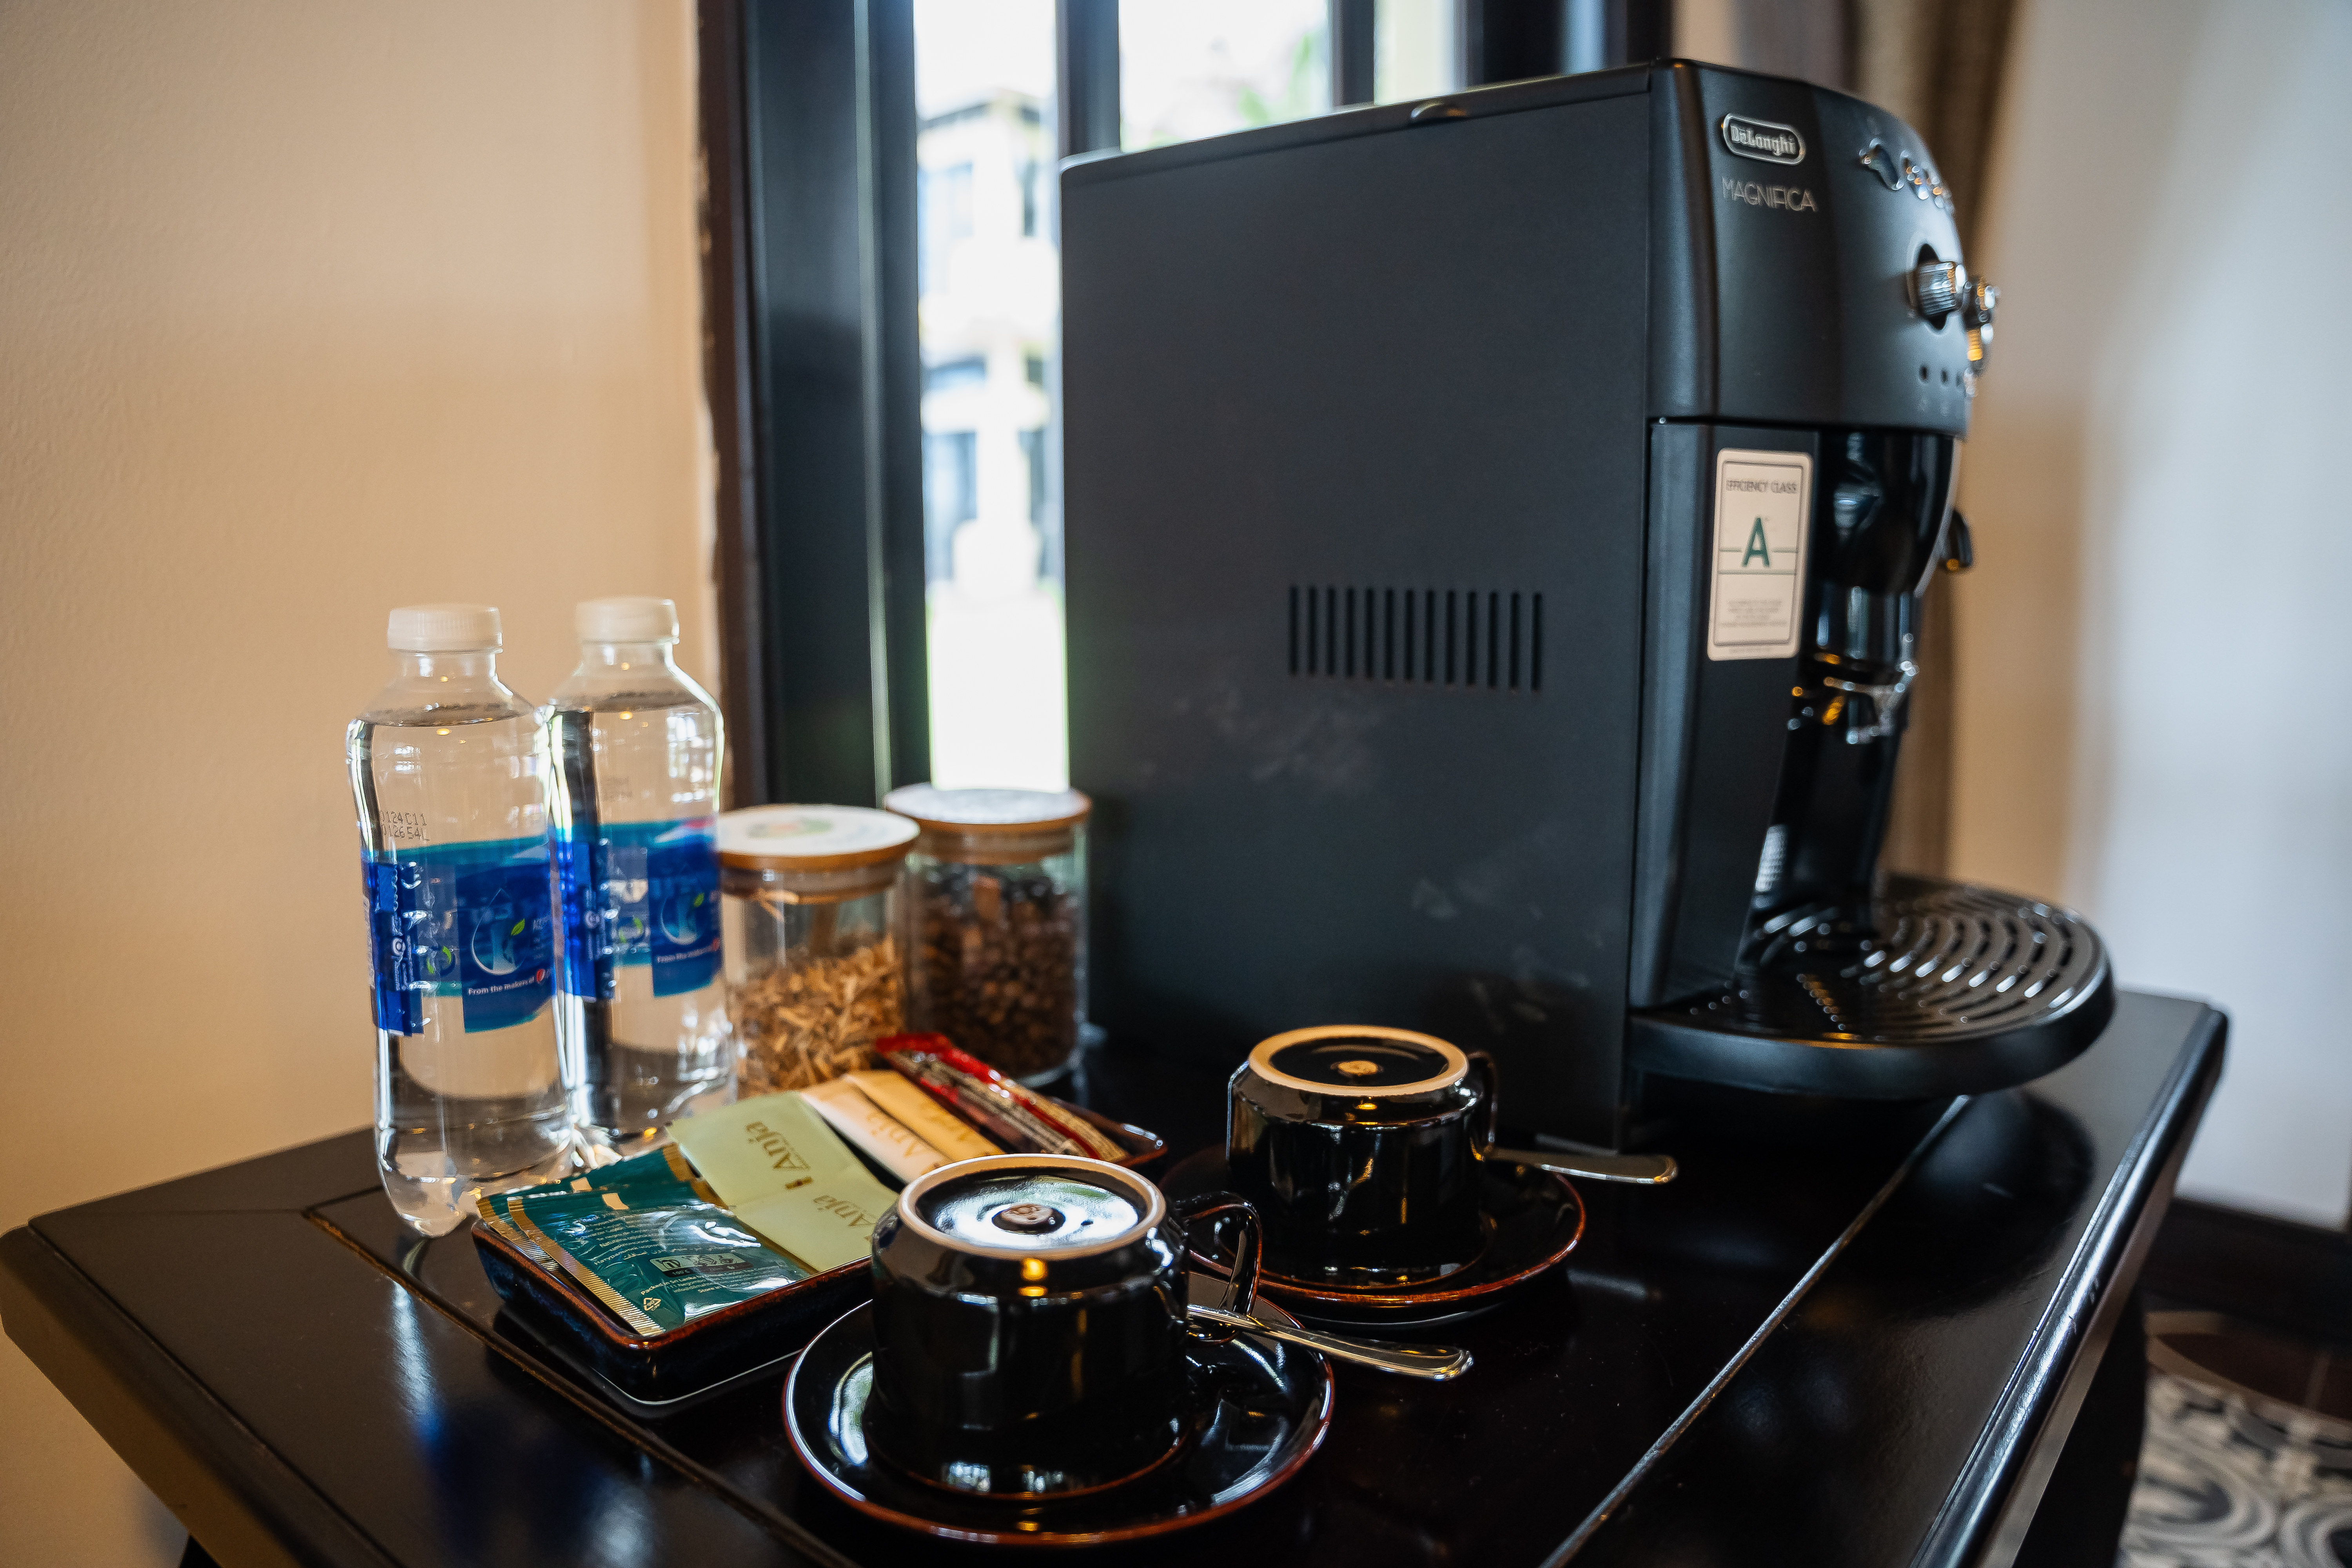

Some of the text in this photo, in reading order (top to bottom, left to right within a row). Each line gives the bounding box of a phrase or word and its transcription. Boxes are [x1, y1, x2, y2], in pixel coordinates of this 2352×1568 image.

[1722, 178, 1818, 212] MAGNIFICA
[1771, 482, 1797, 494] CLASS
[1742, 517, 1769, 567] A
[641, 1283, 663, 1295] Packed
